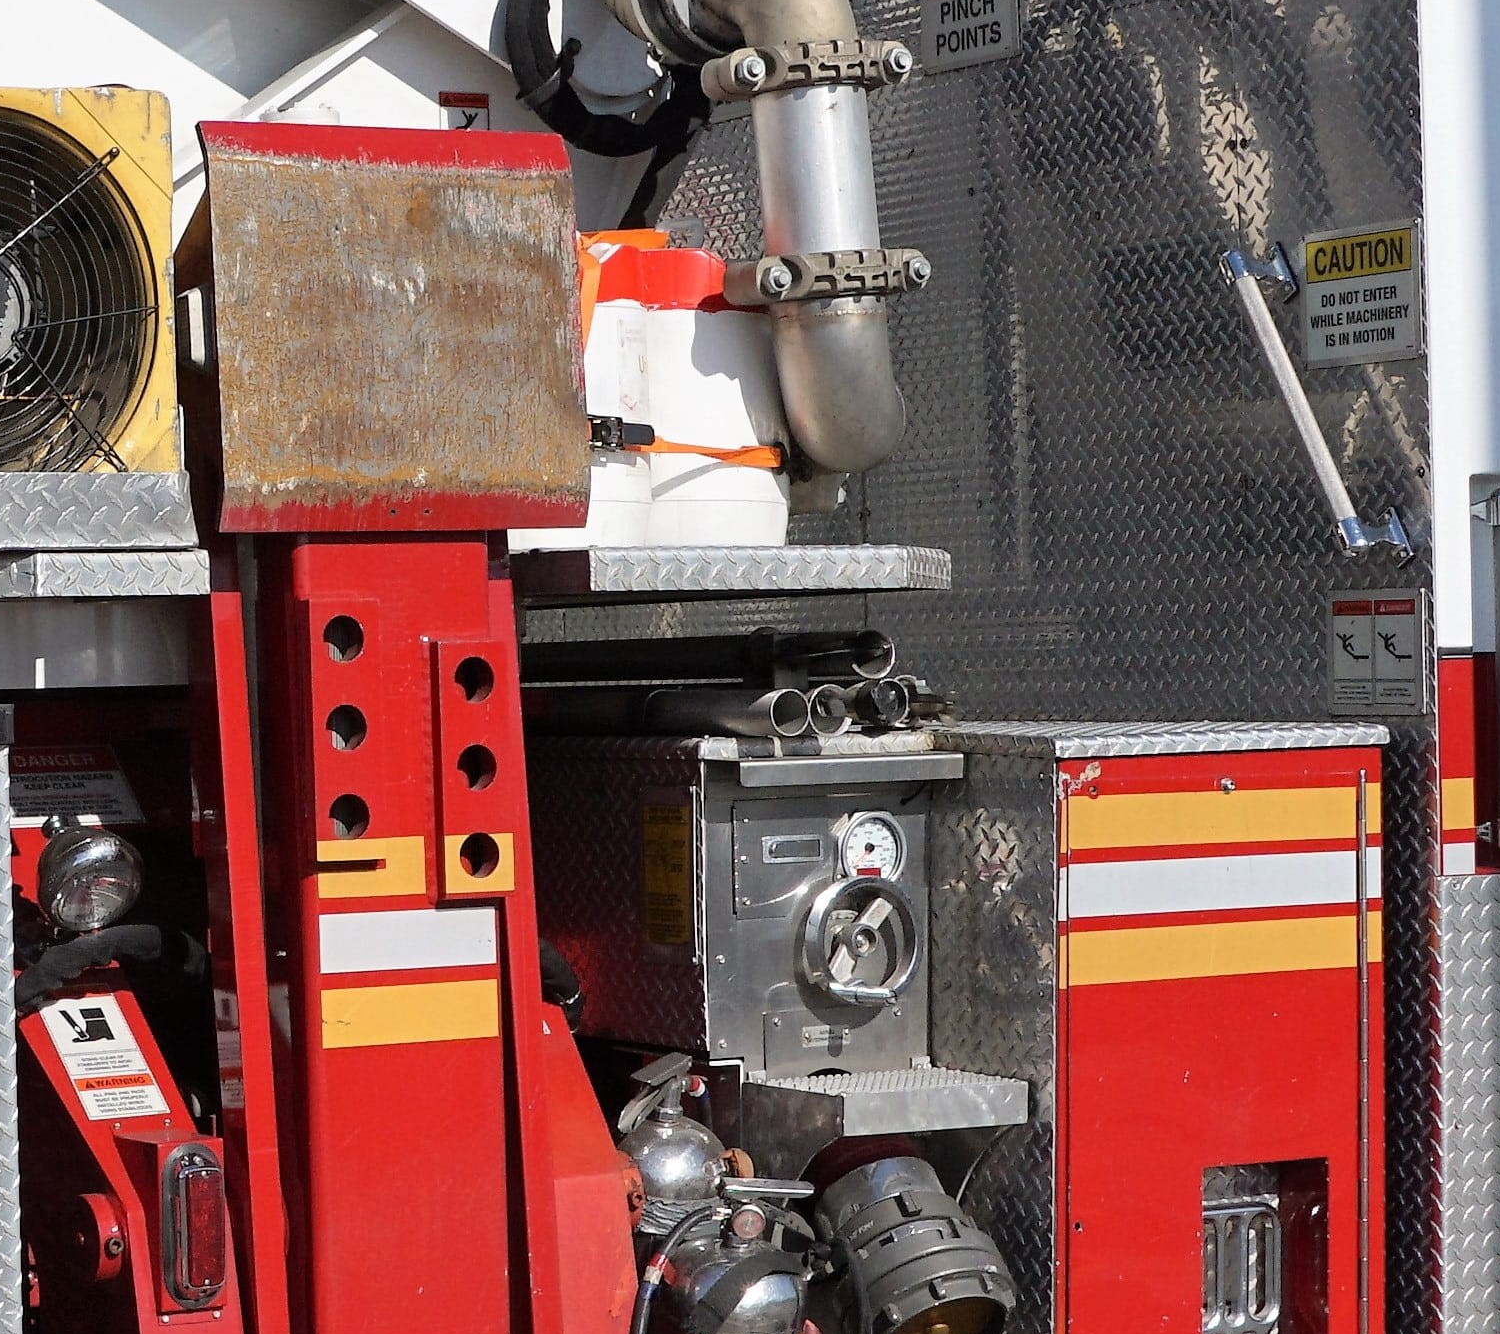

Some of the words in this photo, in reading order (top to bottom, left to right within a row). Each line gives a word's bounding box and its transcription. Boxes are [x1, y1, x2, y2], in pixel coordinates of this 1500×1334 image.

[936, 21, 1002, 56] POINTS
[1314, 236, 1403, 276] CAUTION
[1321, 293, 1335, 307] DO
[1339, 290, 1359, 305] NOT
[1363, 285, 1397, 302] ENTER
[1310, 313, 1344, 329] WHILE
[1346, 304, 1409, 325] MACHINERY
[1325, 333, 1335, 347] IS
[1339, 331, 1350, 345] IN
[1352, 327, 1395, 344] MOTION
[12, 754, 96, 767] DANGER
[95, 1076, 146, 1088] WARNING
